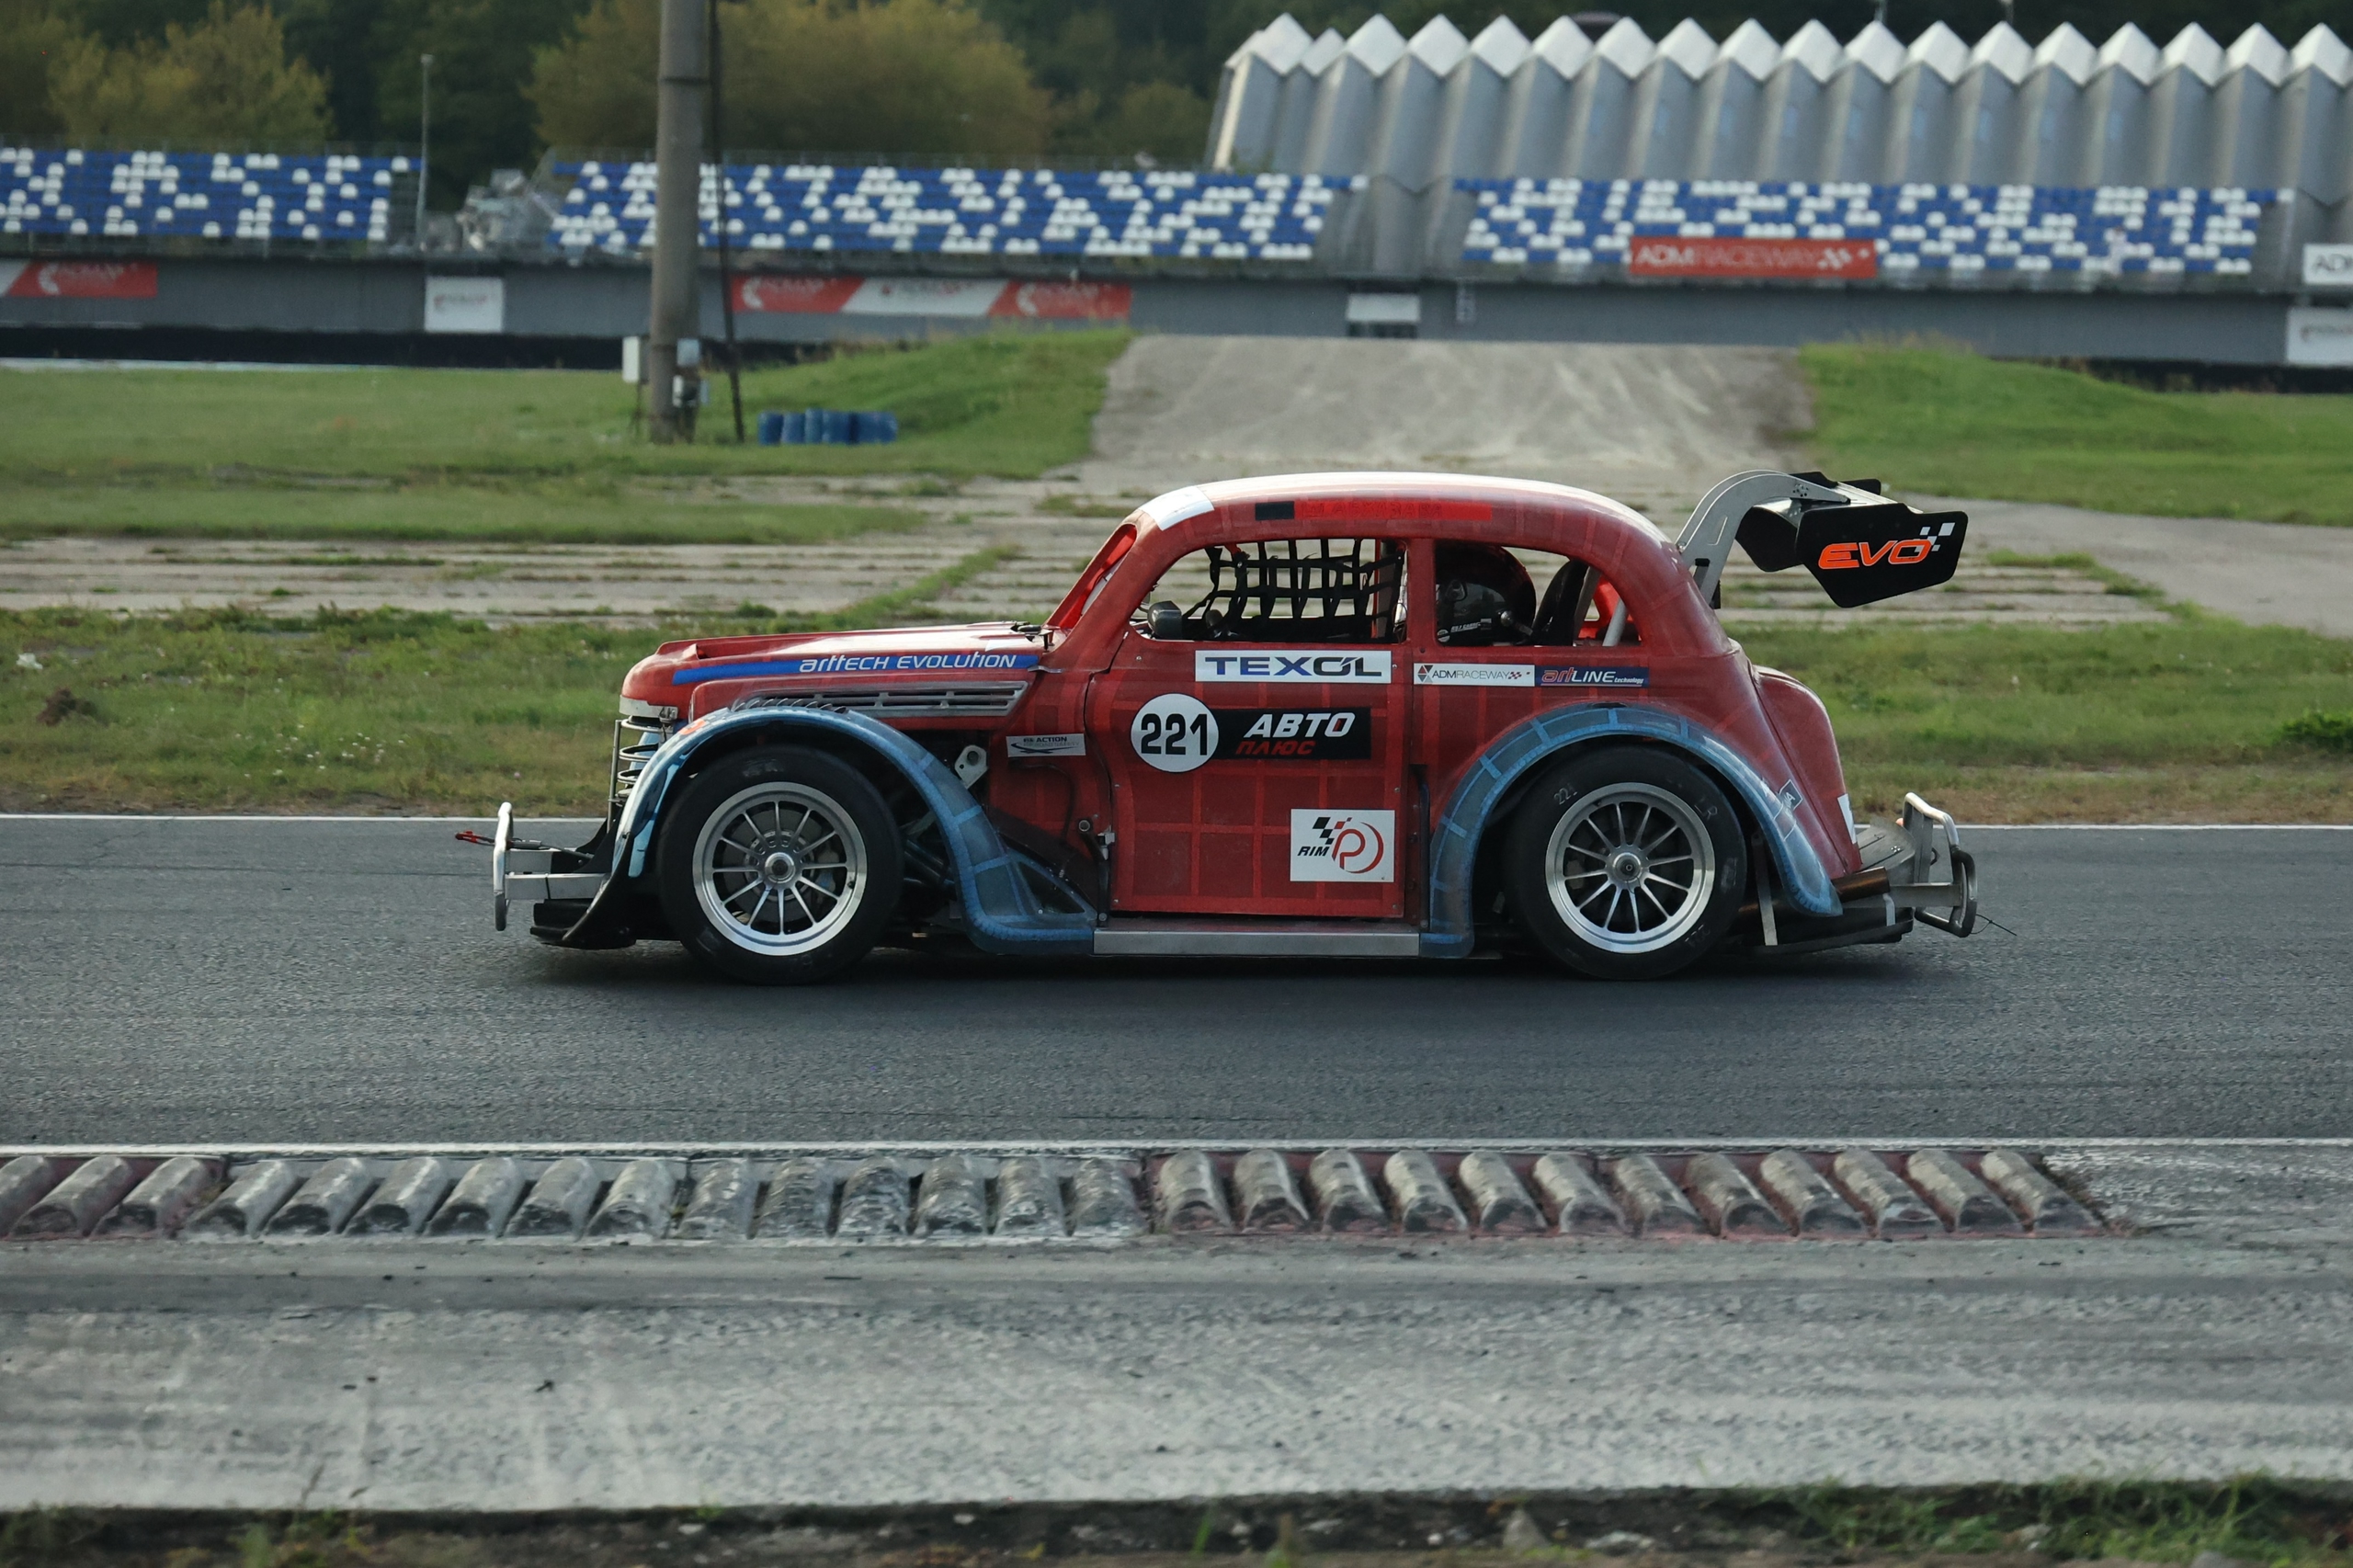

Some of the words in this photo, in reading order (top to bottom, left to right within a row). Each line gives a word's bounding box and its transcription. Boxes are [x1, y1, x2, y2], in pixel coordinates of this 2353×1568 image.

[1817, 539, 1932, 570] EVO
[1204, 656, 1382, 677] TEXOL
[1141, 712, 1208, 756] 221
[1243, 711, 1356, 738] АВТО
[1235, 740, 1316, 756] ПЛЮС
[1297, 846, 1331, 857] RIM
